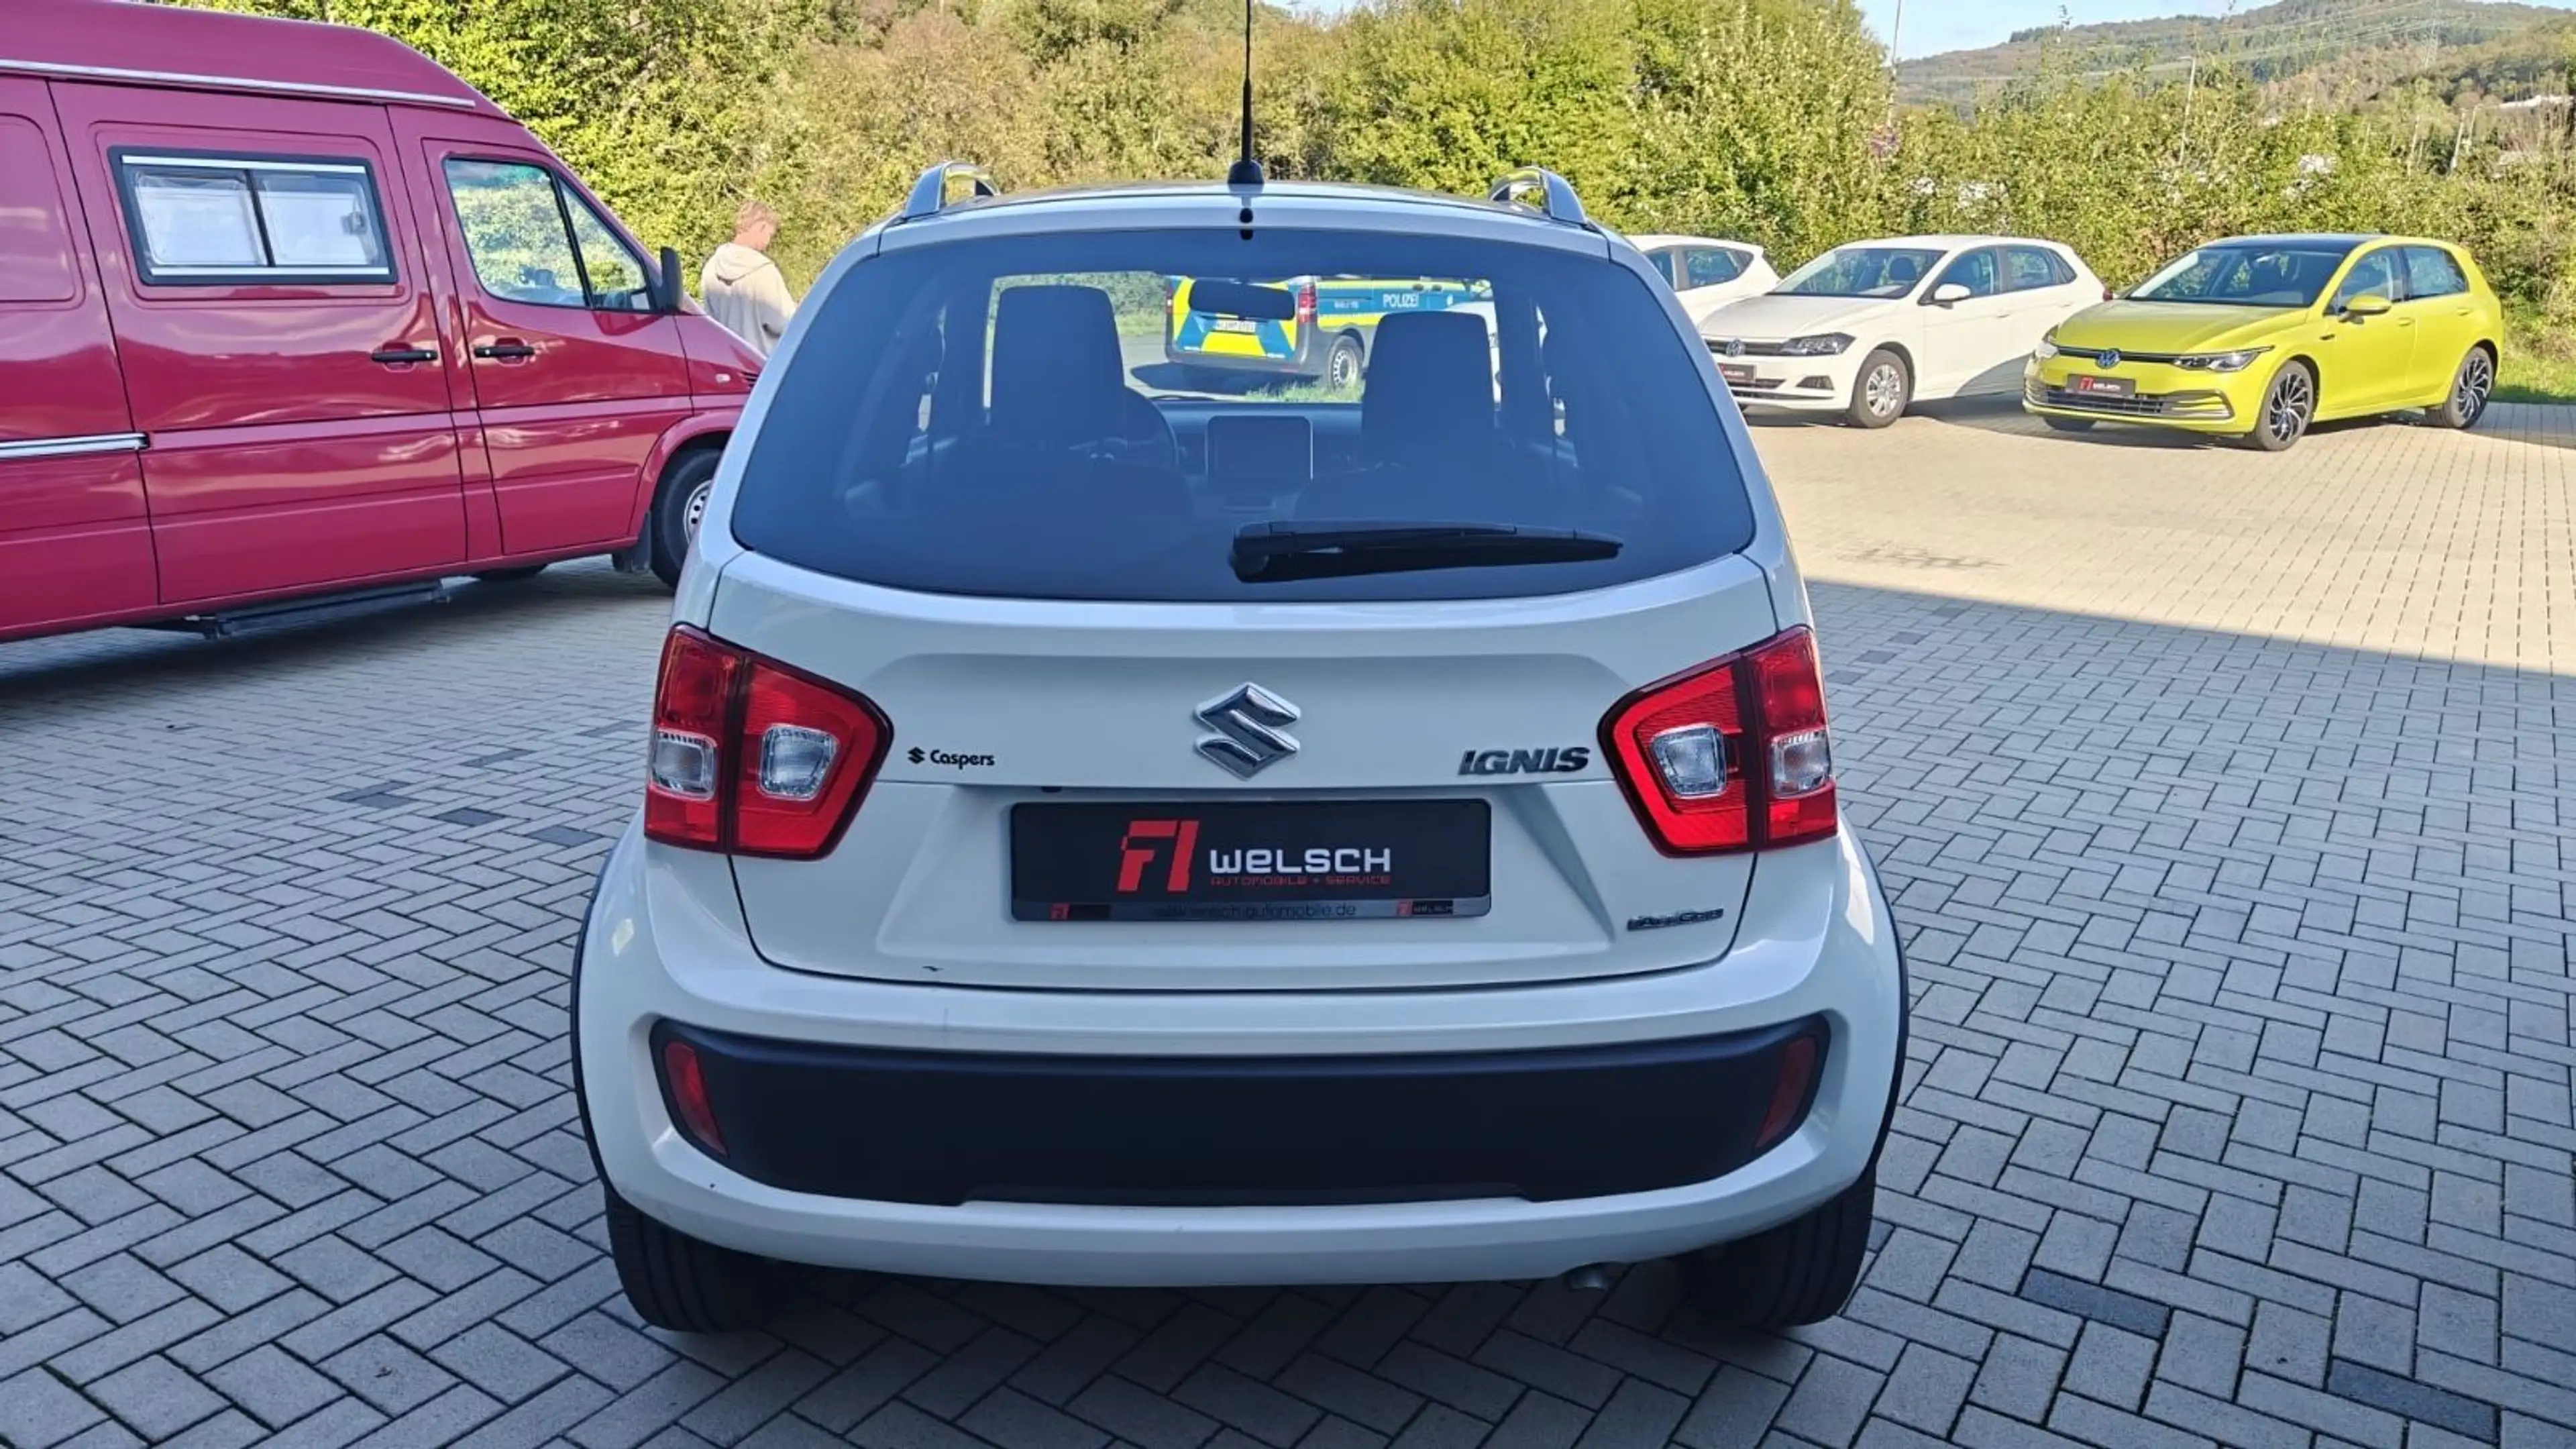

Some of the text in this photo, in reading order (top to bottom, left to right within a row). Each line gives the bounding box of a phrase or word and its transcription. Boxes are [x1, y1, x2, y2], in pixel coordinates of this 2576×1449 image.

[1383, 293, 1419, 308] POLIZEI
[930, 749, 996, 770] Caspers
[1458, 747, 1591, 775] IGNIS
